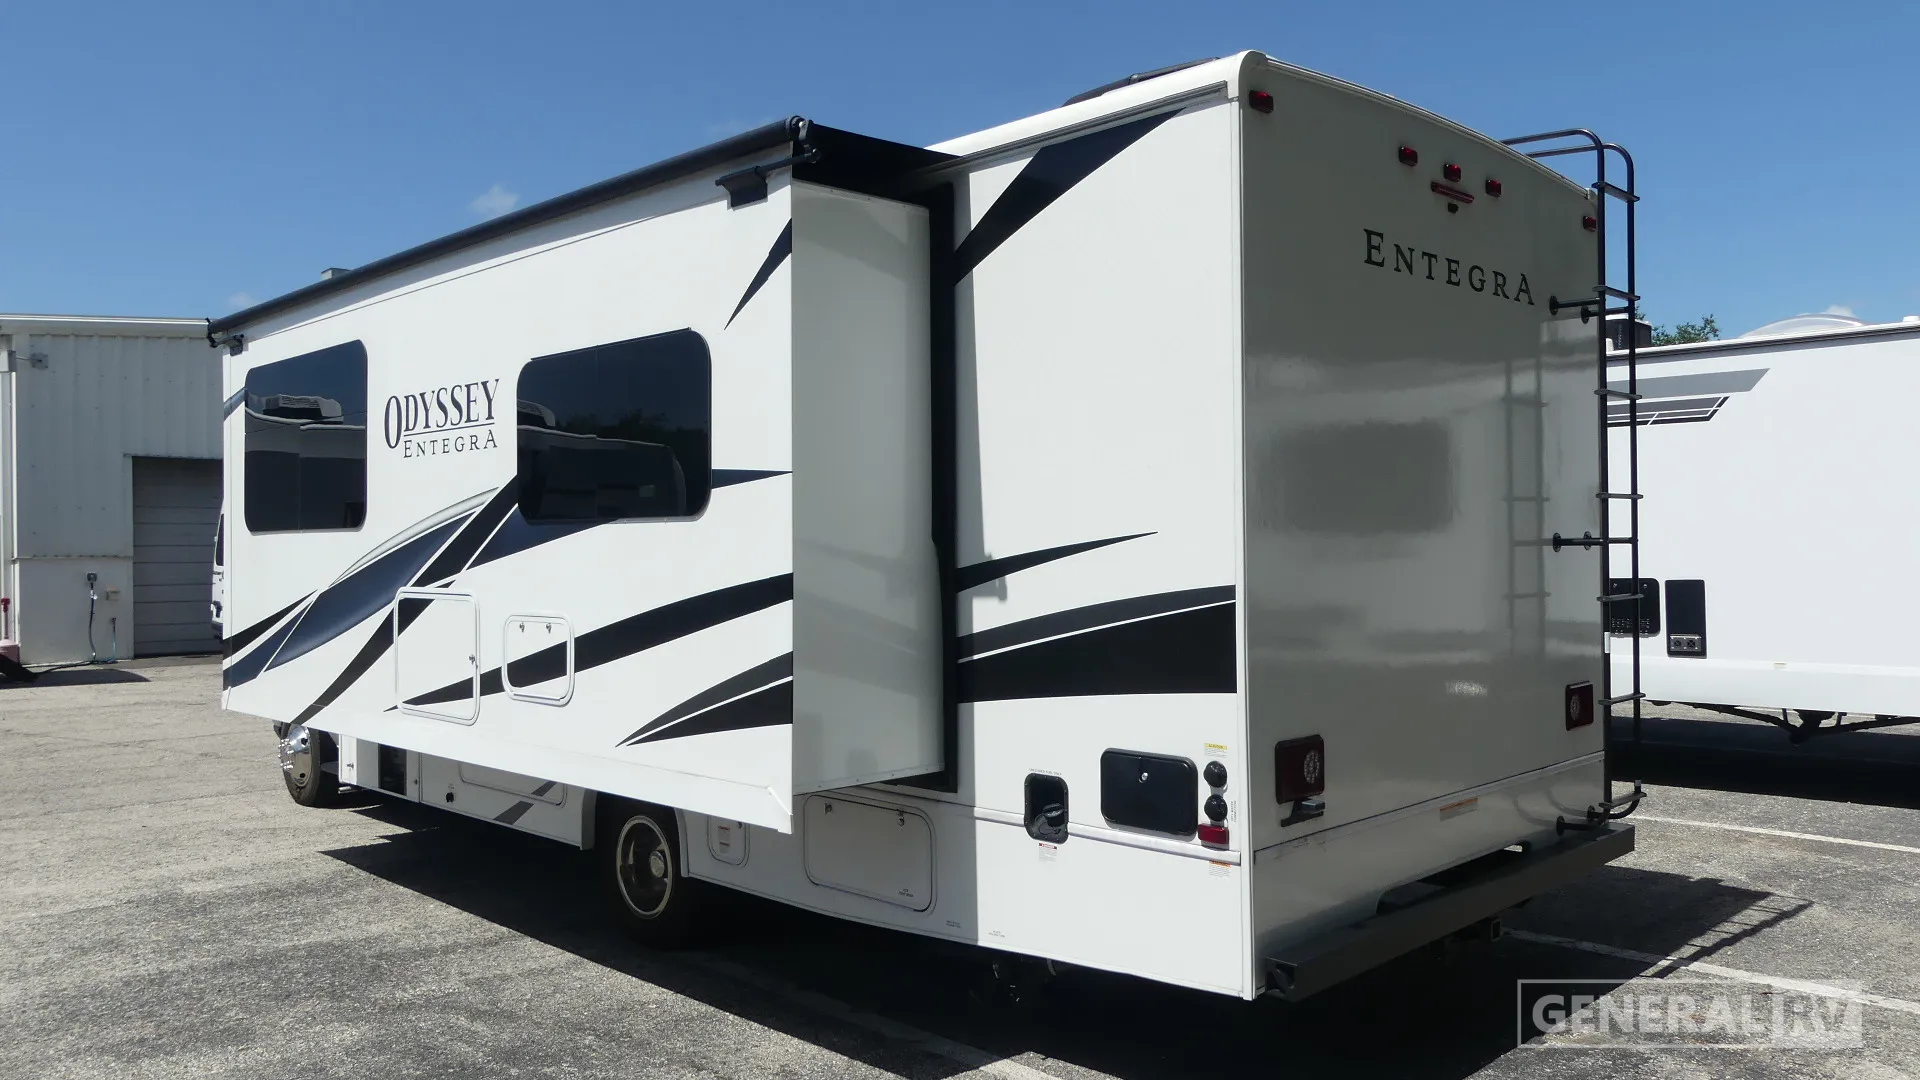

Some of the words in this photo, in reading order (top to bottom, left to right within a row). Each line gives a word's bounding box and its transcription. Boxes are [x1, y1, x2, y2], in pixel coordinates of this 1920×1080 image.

[1363, 228, 1535, 305] ENTEGRA
[384, 378, 500, 449] ODYSSEY
[403, 429, 498, 458] ENTEGRA
